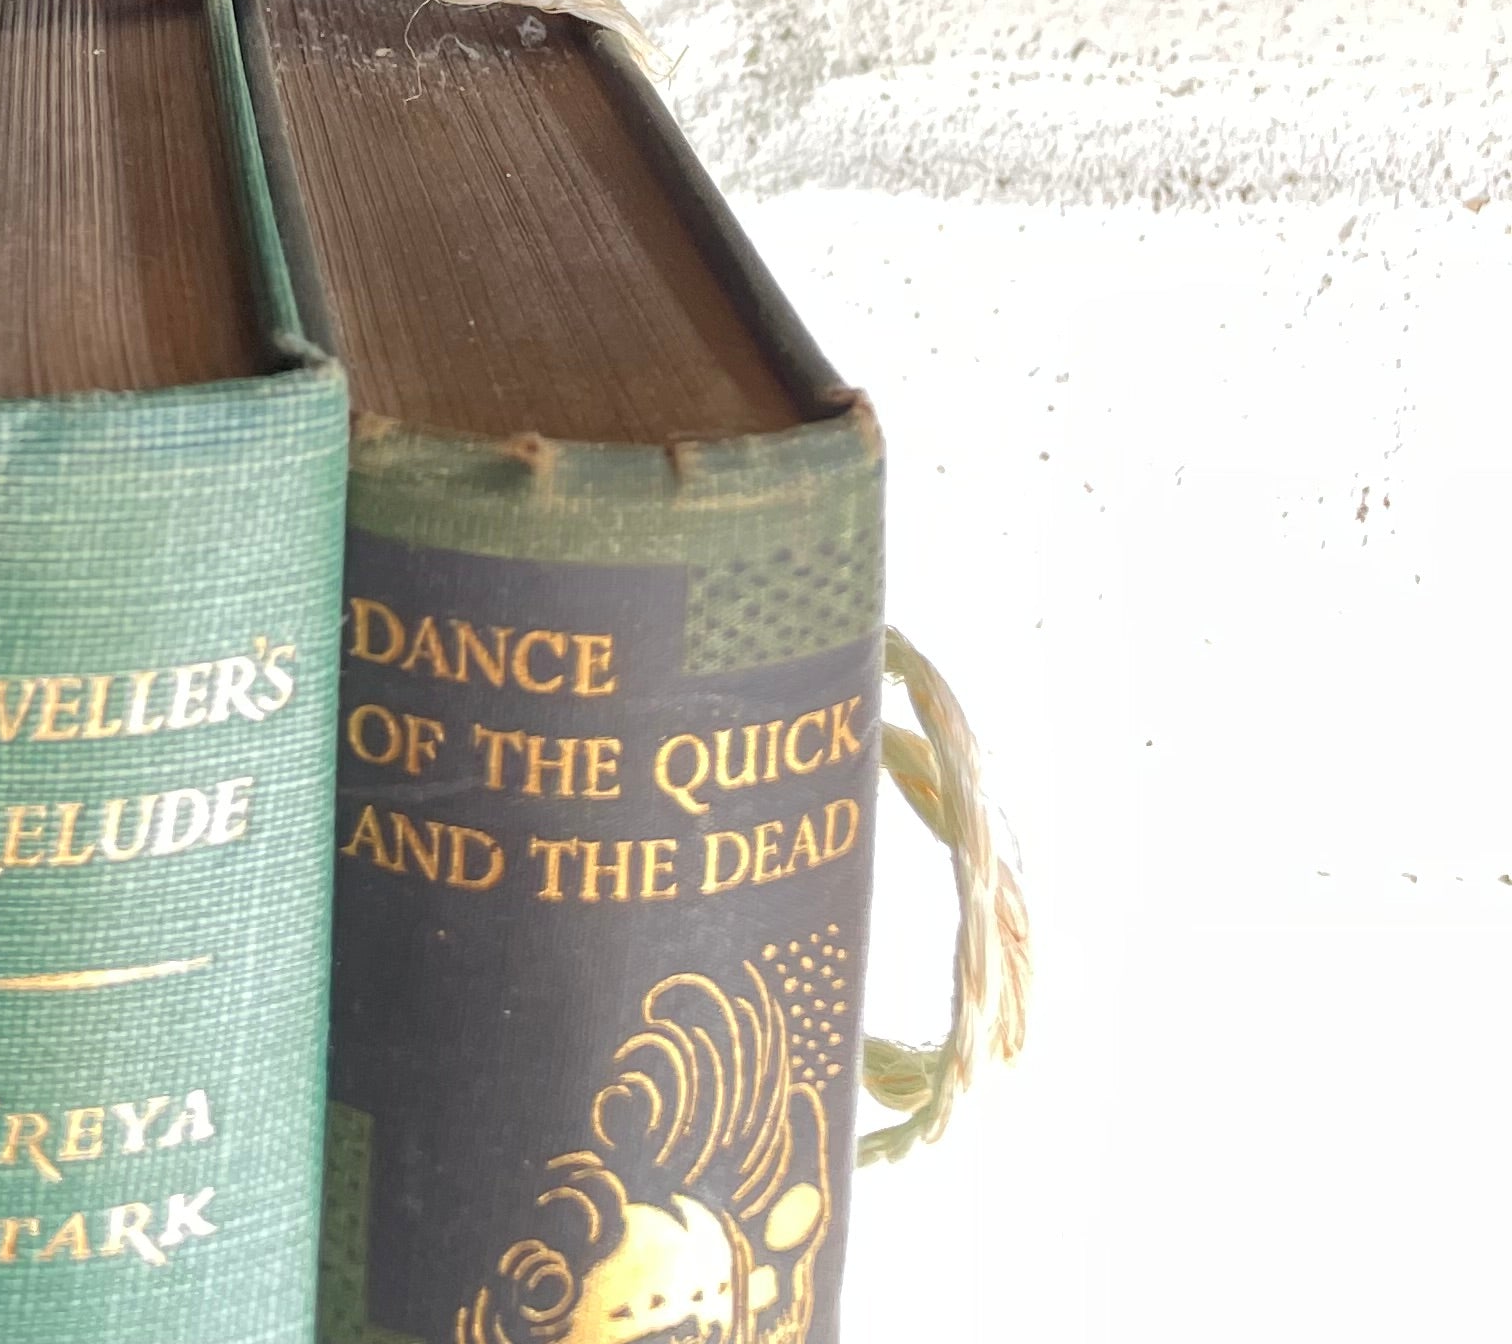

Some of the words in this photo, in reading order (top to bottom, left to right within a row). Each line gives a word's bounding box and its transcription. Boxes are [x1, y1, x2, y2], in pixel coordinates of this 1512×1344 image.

[348, 597, 620, 696] DANCE
[347, 703, 445, 775] OF
[469, 721, 623, 800] THE
[653, 696, 863, 816] QUICK
[340, 803, 505, 891] AND
[529, 833, 679, 903] THE
[700, 798, 861, 896] DEAD
